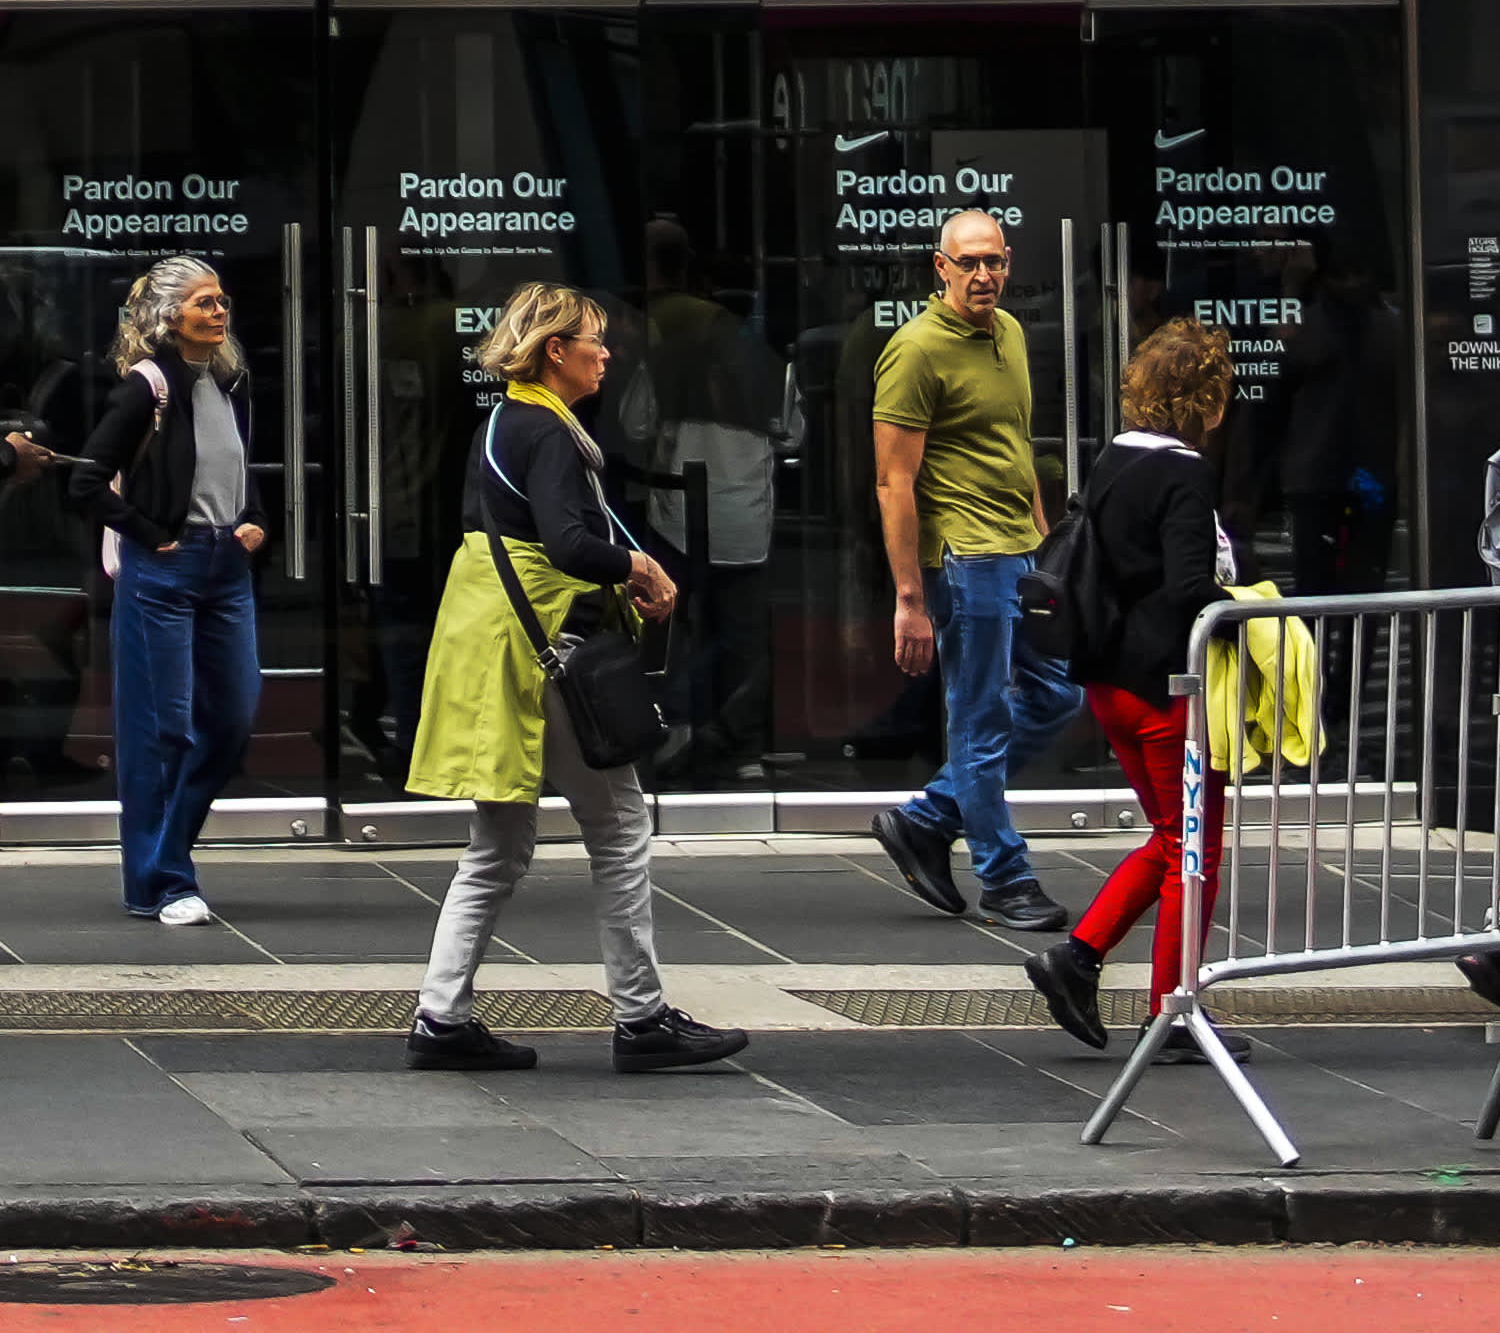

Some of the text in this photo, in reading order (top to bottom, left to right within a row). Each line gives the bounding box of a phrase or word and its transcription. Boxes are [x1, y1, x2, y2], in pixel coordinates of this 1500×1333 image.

[63, 173, 240, 201] Pardon Our
[399, 172, 567, 199] Pardon Our
[836, 167, 1013, 195] Pardon Our
[1155, 165, 1326, 193] Pardon Our
[62, 207, 249, 240] Appearance
[398, 206, 576, 237] Appearance
[1155, 200, 1336, 230] Appearance
[1193, 298, 1303, 326] ENTER
[1451, 356, 1479, 370] THE
[1234, 384, 1264, 400] 入口
